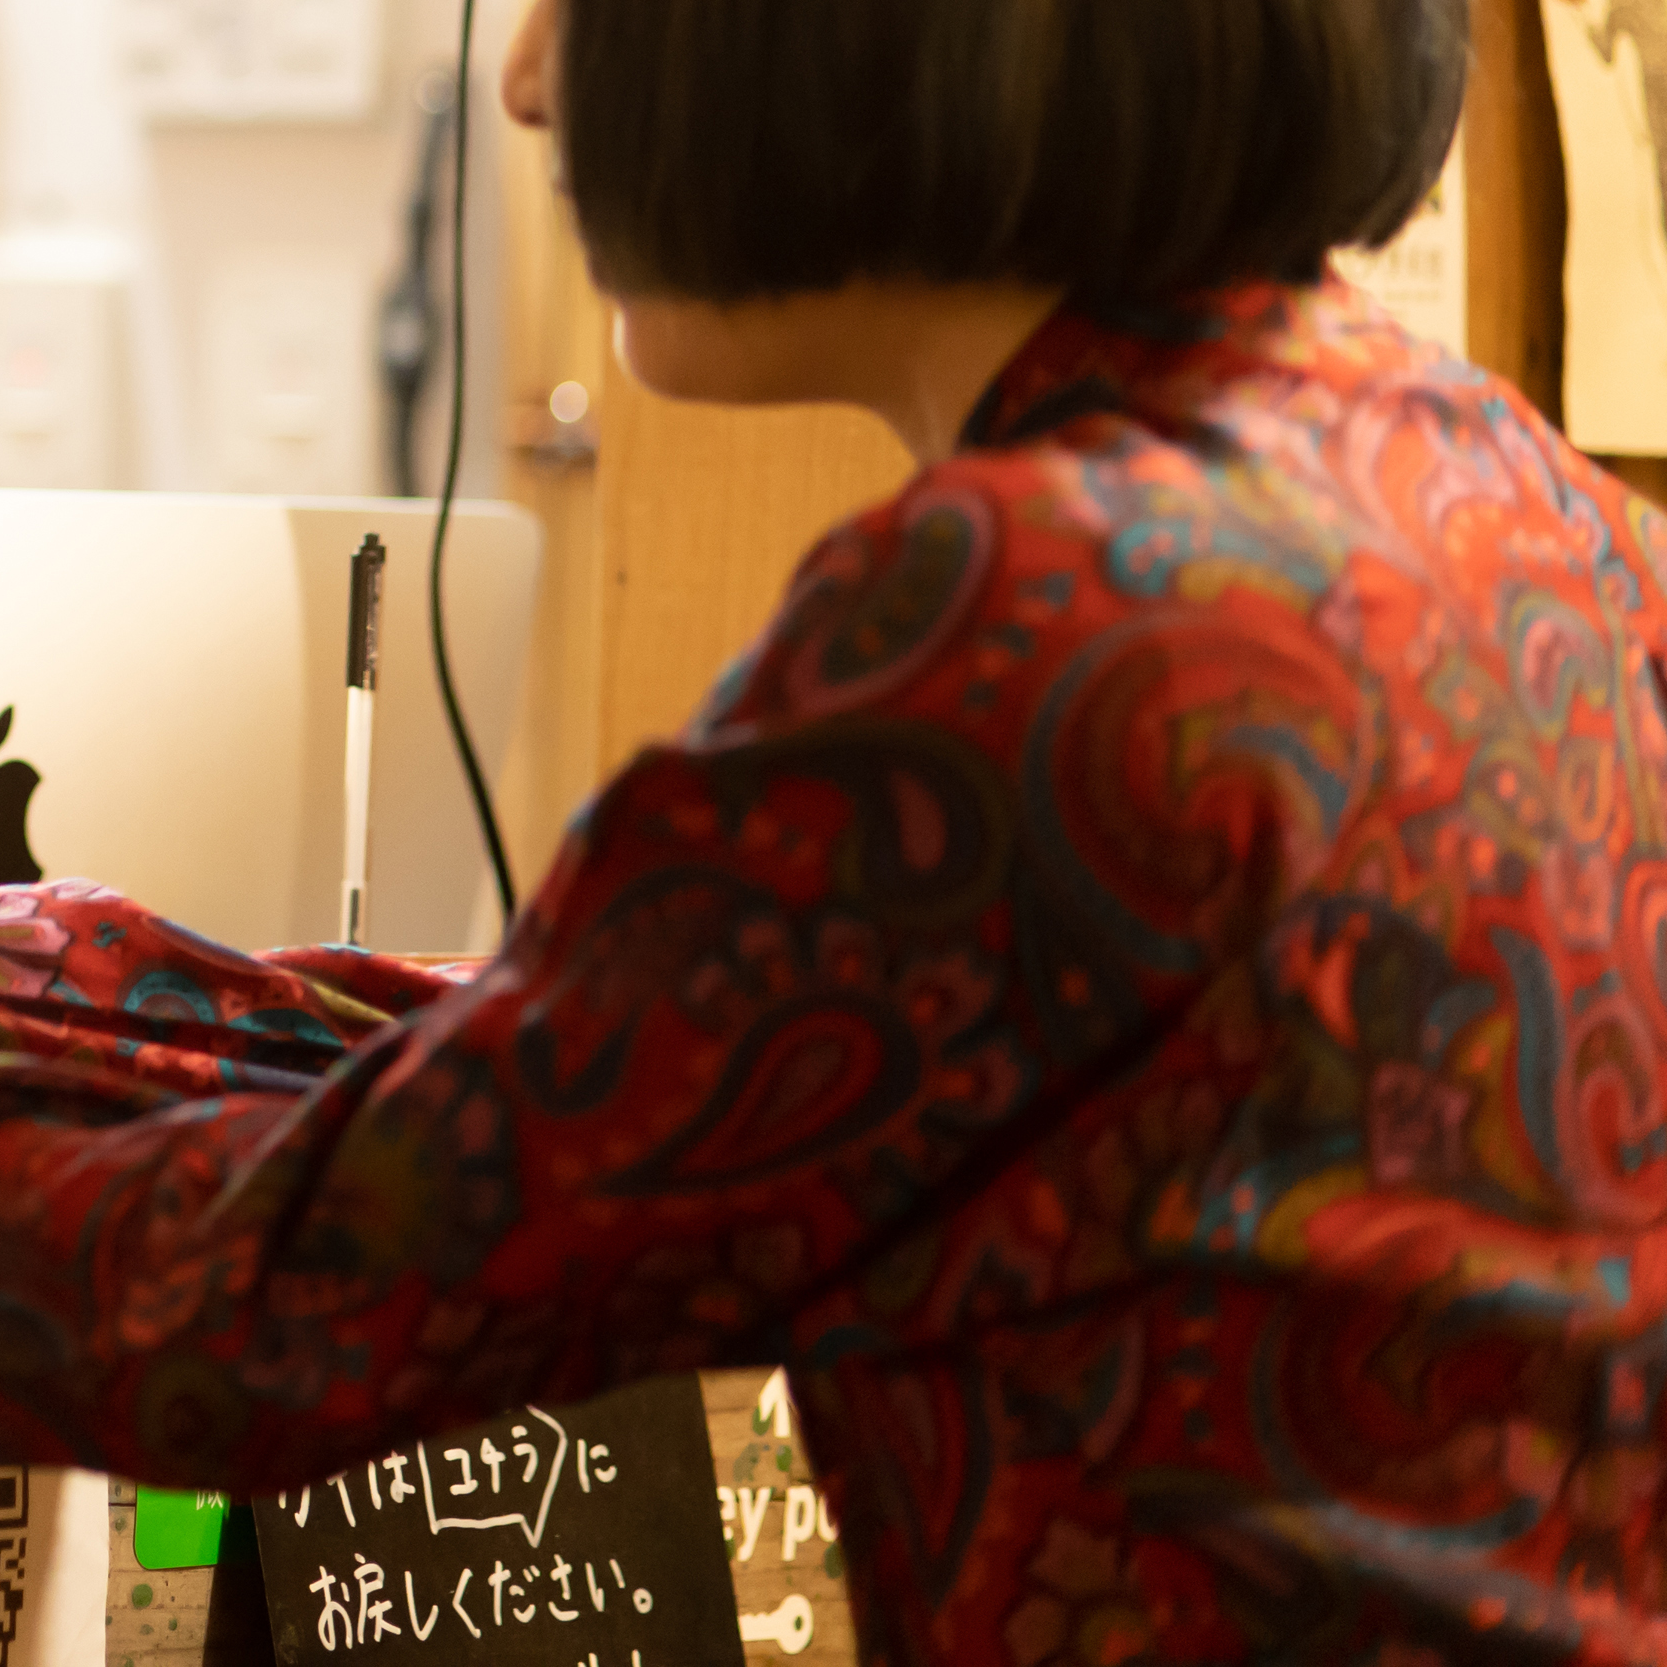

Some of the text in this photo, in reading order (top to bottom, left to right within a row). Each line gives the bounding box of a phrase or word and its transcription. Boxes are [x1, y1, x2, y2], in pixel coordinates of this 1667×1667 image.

[716, 1486, 772, 1563] ey
[308, 1552, 653, 1652] お戻しください。
